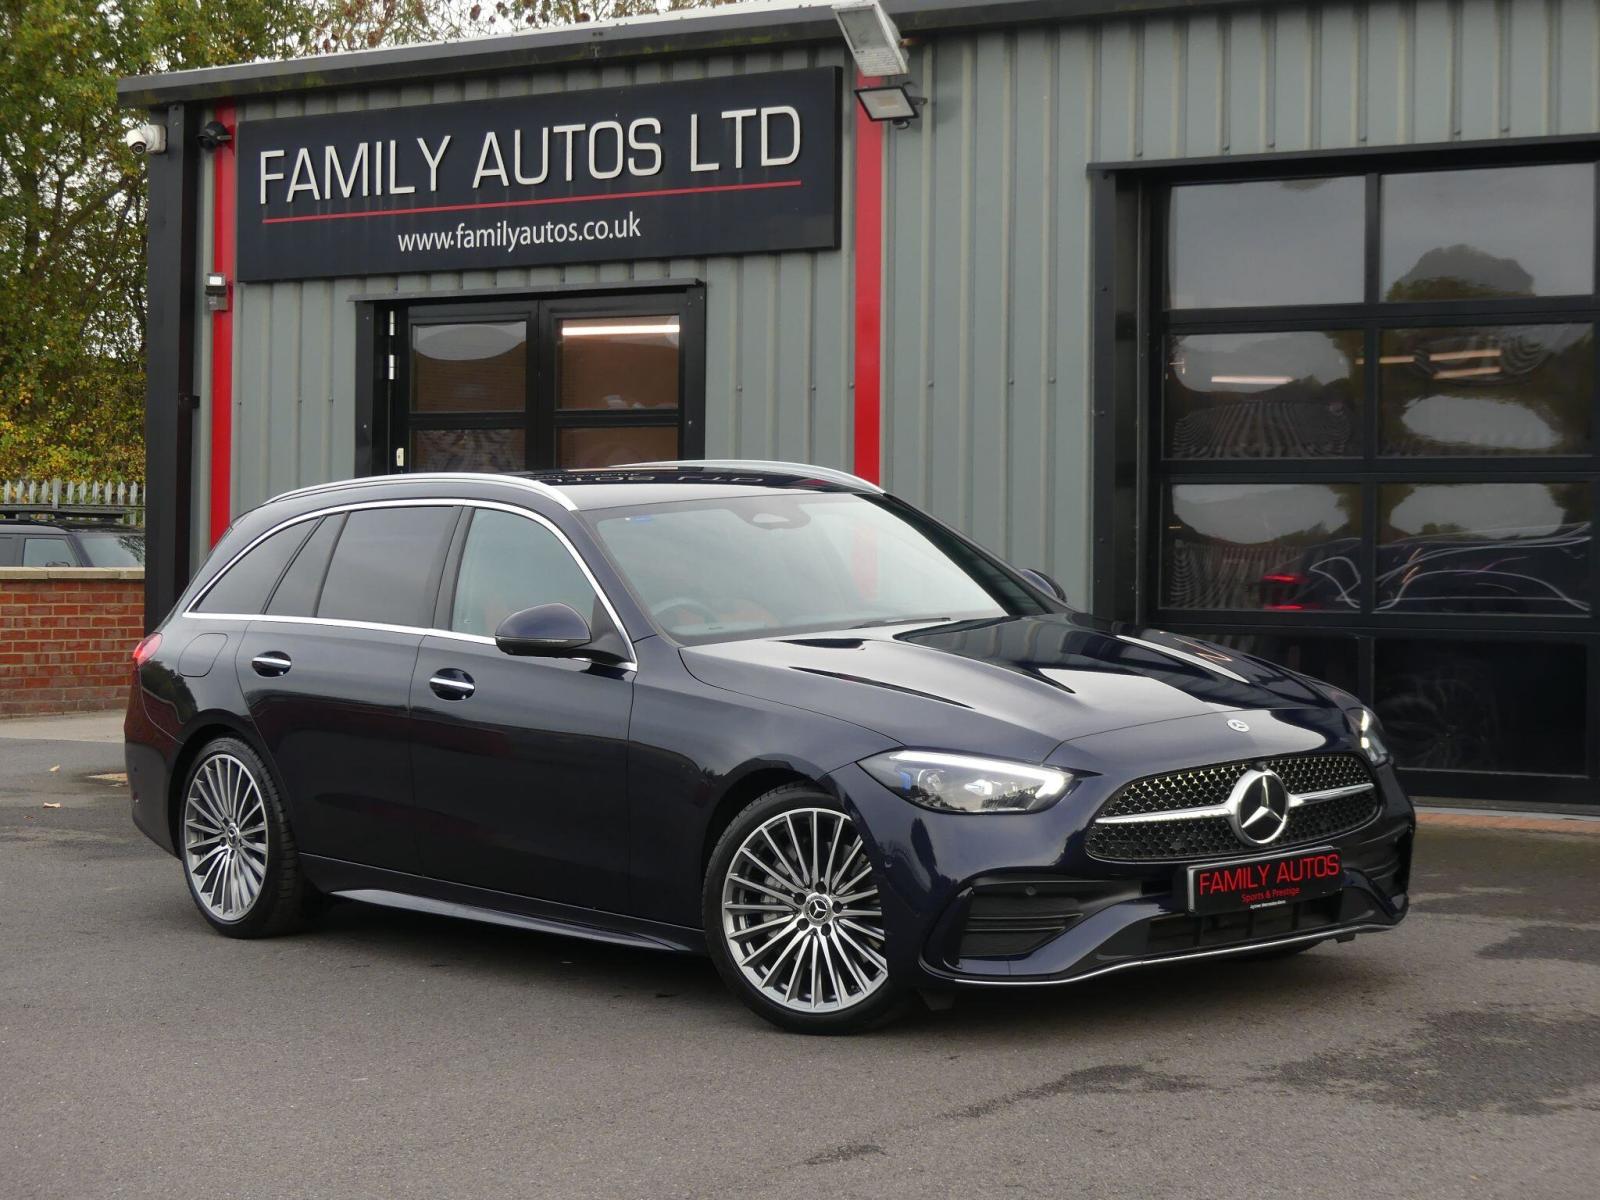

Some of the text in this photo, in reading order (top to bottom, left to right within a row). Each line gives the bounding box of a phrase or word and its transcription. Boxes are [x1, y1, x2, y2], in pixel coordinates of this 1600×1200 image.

[259, 104, 802, 205] FAMILY AUTOS LTD
[398, 211, 642, 253] www.familyautos.co.uk
[1199, 854, 1339, 896] FAMILY AUTOS
[1241, 892, 1265, 904] Sports
[1272, 887, 1300, 898] Prestige
